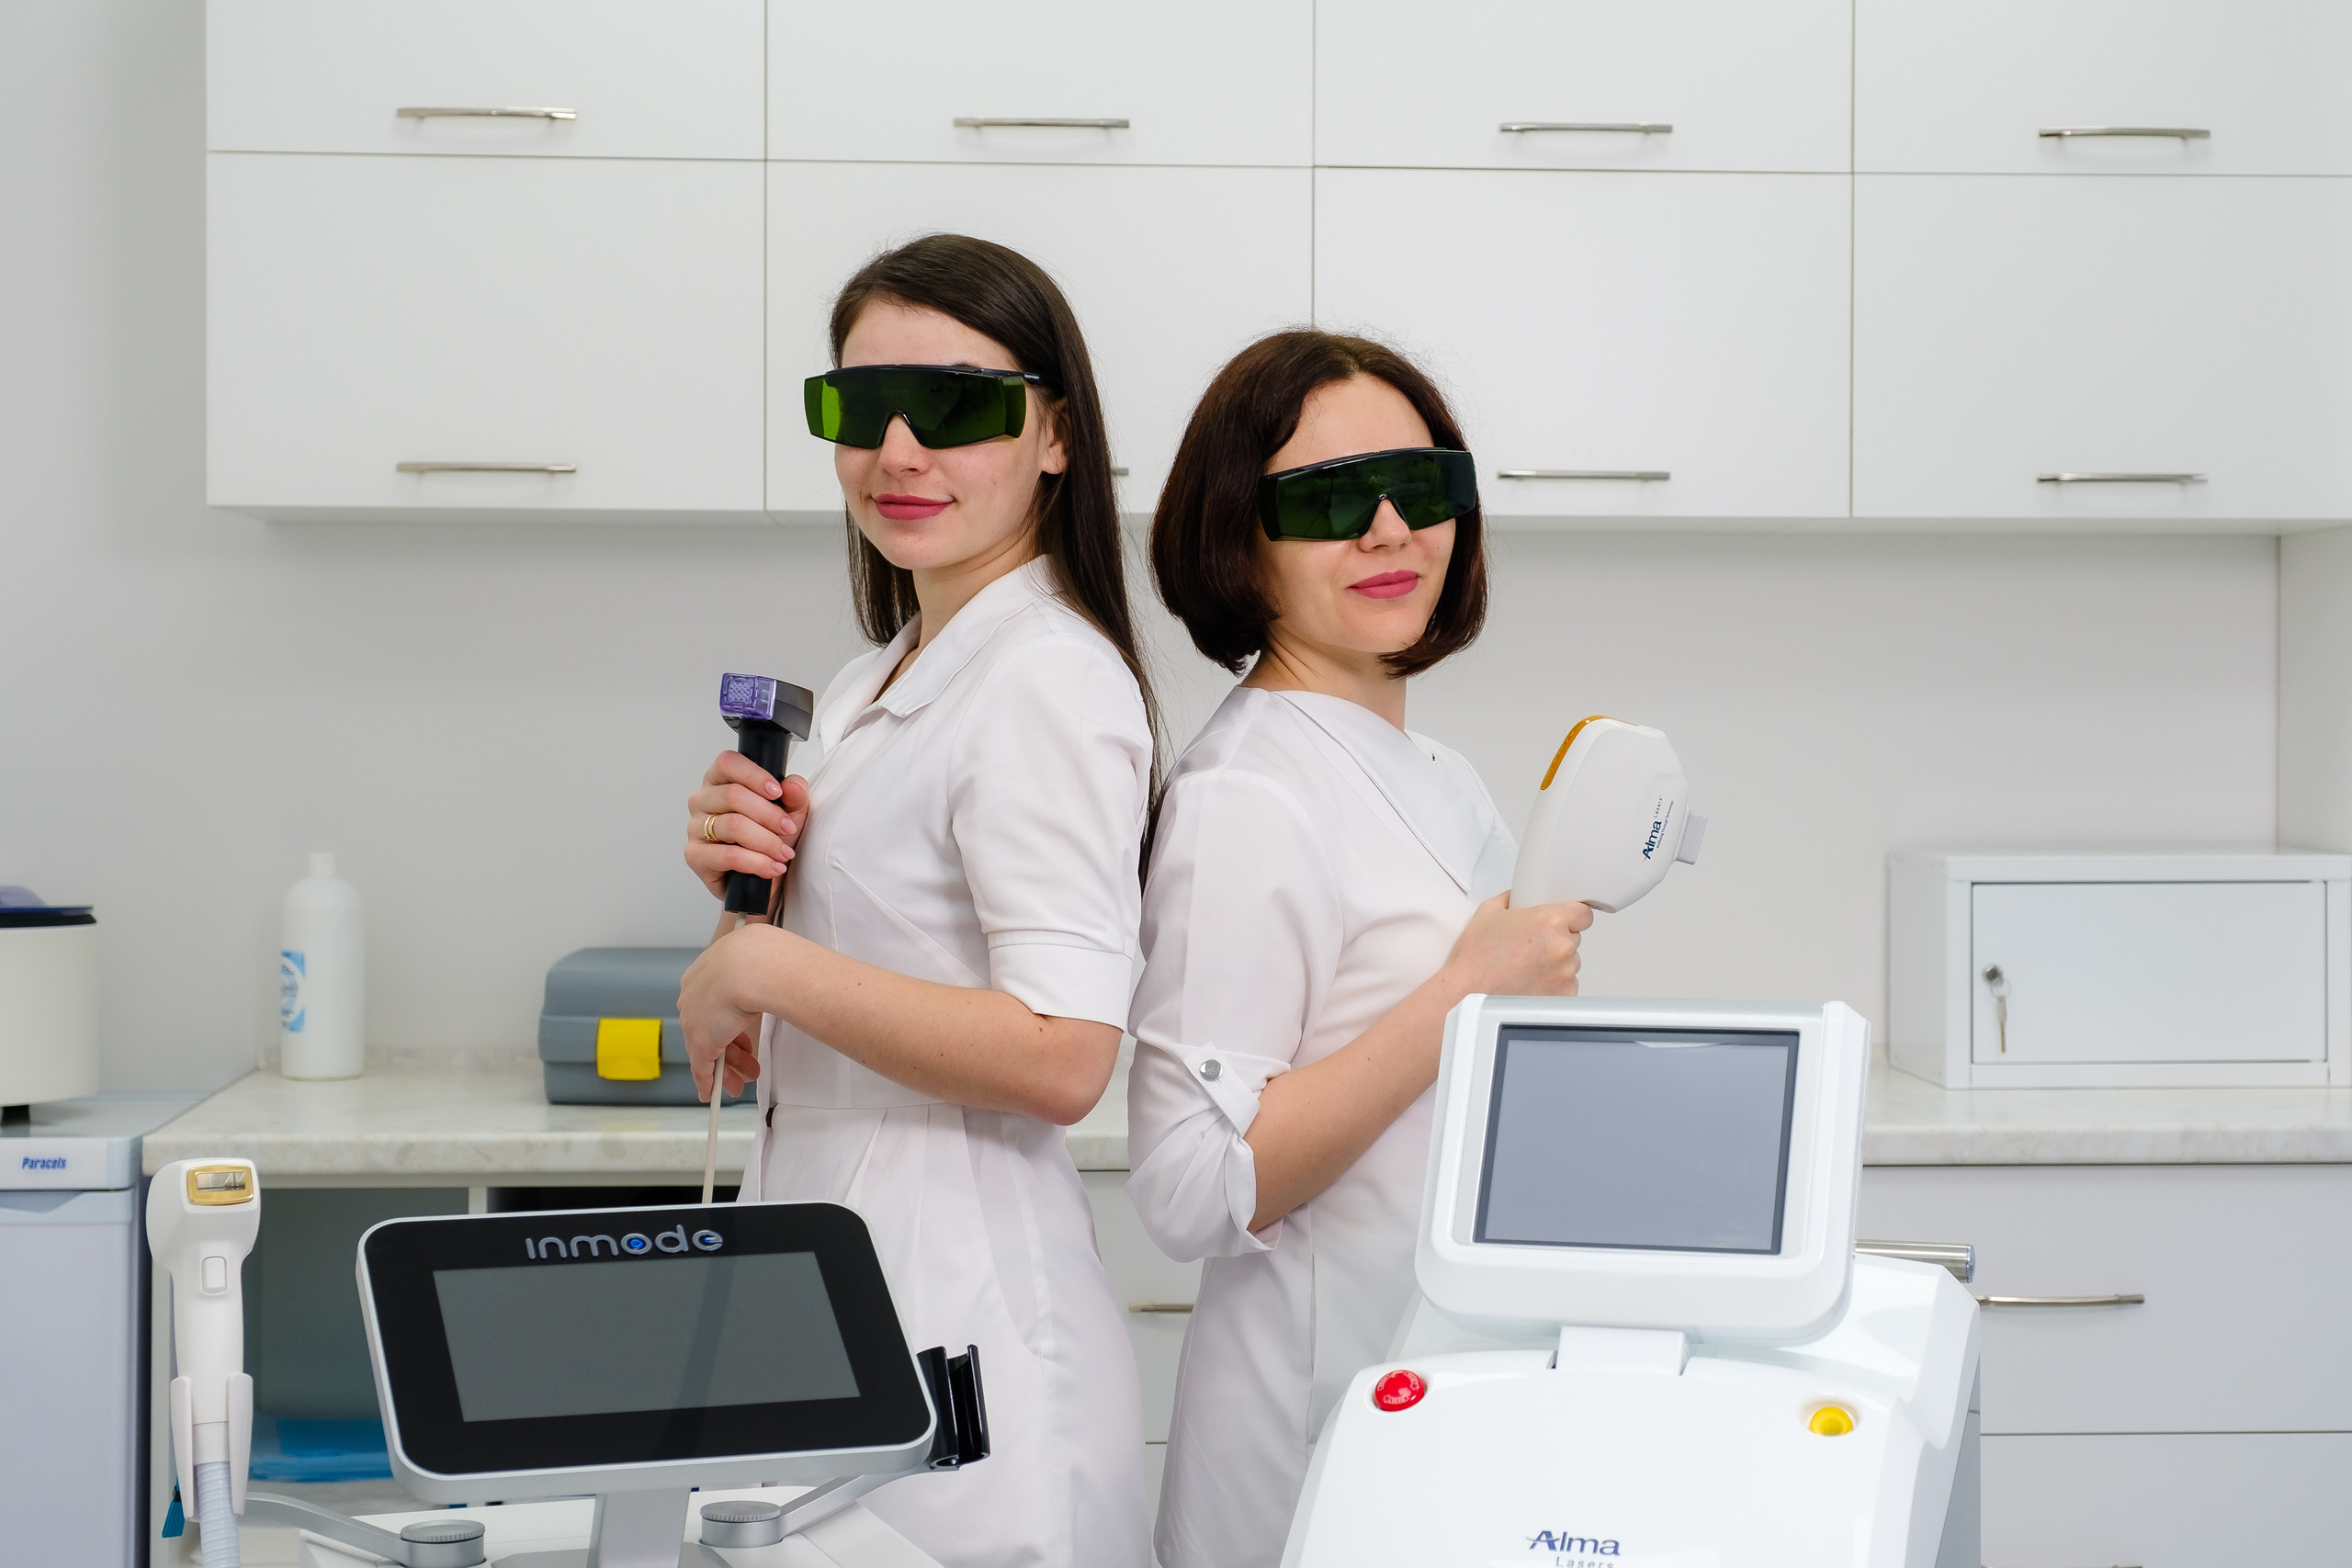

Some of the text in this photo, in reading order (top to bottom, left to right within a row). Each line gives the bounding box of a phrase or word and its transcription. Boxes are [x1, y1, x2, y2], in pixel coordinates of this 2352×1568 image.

[1642, 820, 1662, 861] Alma
[21, 1156, 67, 1170] Paracels
[1526, 1529, 1622, 1556] Alma
